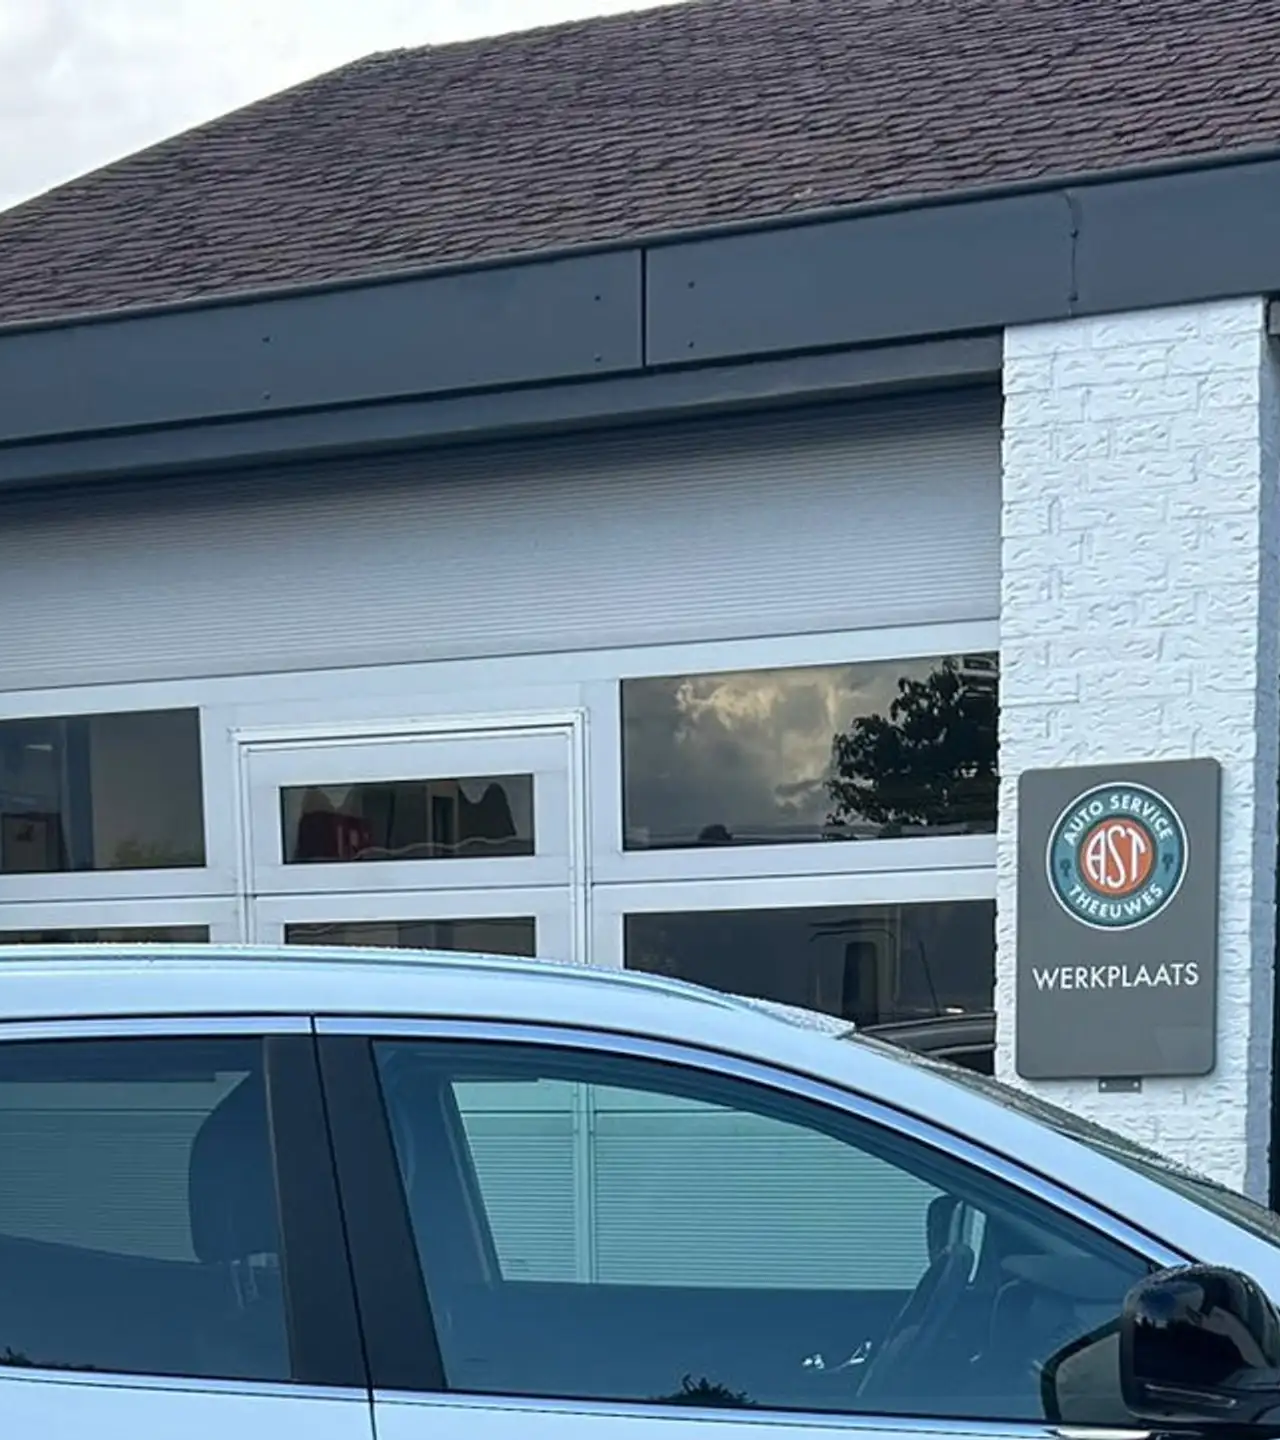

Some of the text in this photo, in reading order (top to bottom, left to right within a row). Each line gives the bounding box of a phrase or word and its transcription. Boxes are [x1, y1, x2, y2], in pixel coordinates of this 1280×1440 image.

[1062, 794, 1175, 845] AUTO SERVICE
[1085, 825, 1147, 888] AST
[1067, 882, 1164, 919] THEEUWES
[1032, 962, 1200, 991] WERKPLAATS
